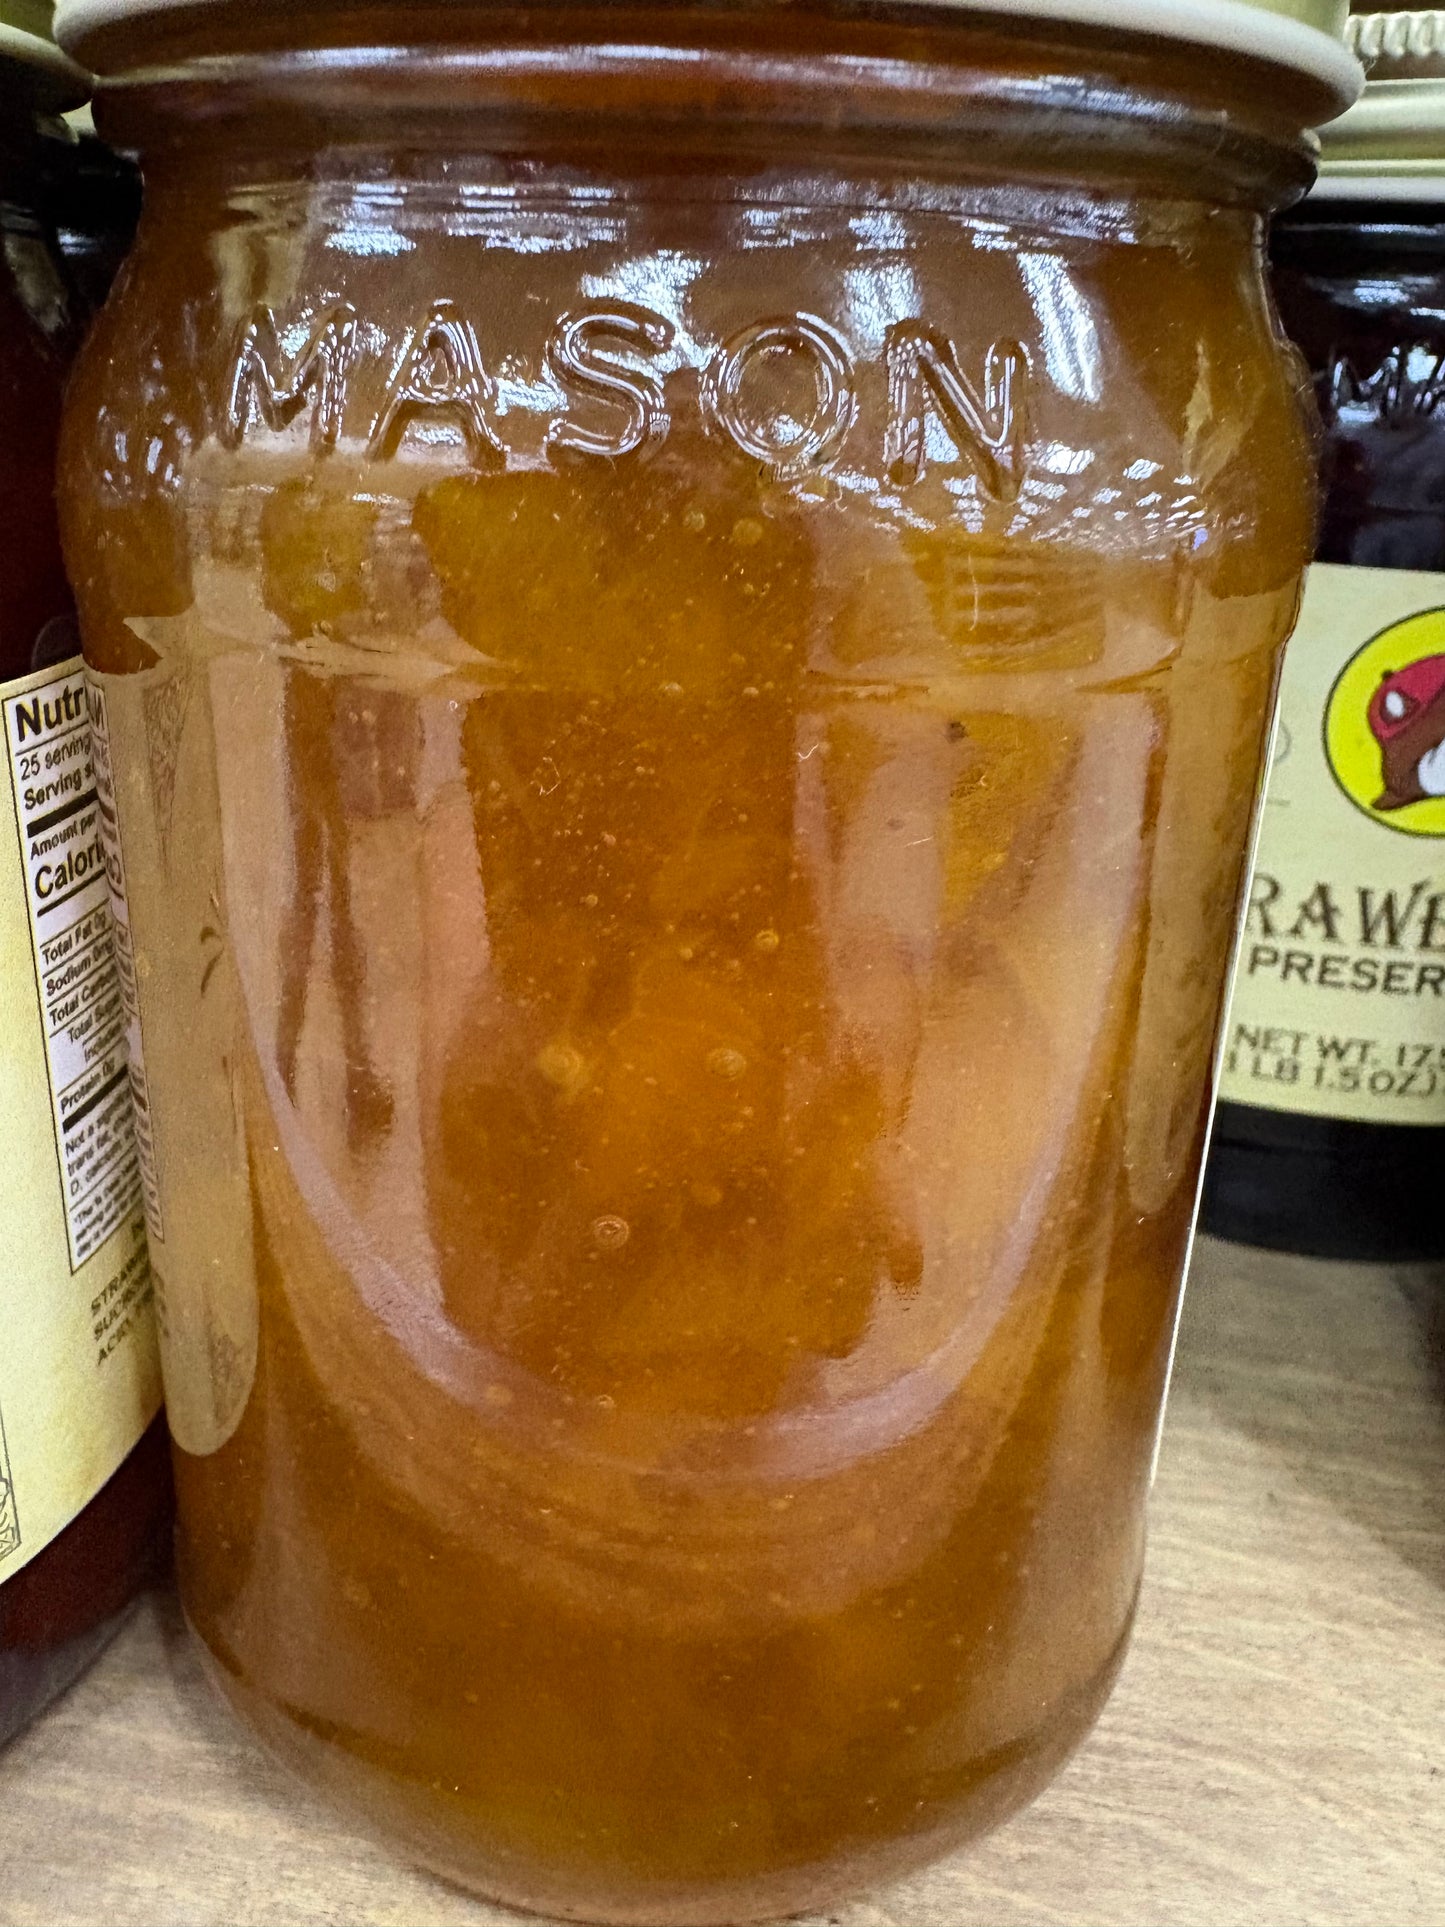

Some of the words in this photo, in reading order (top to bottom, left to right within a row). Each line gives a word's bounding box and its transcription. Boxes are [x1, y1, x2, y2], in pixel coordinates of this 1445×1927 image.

[224, 297, 1033, 504] MASON
[15, 685, 84, 742] Nutr
[20, 752, 41, 781] 25
[24, 768, 82, 810] Serving
[31, 820, 77, 860] Amount
[42, 934, 72, 965] Total
[75, 920, 92, 944] Fat
[46, 955, 91, 997] Sodium
[49, 993, 79, 1026] Total
[1234, 1023, 1309, 1056] NET
[1251, 1054, 1298, 1085] LB
[1314, 1063, 1361, 1093] 1.5
